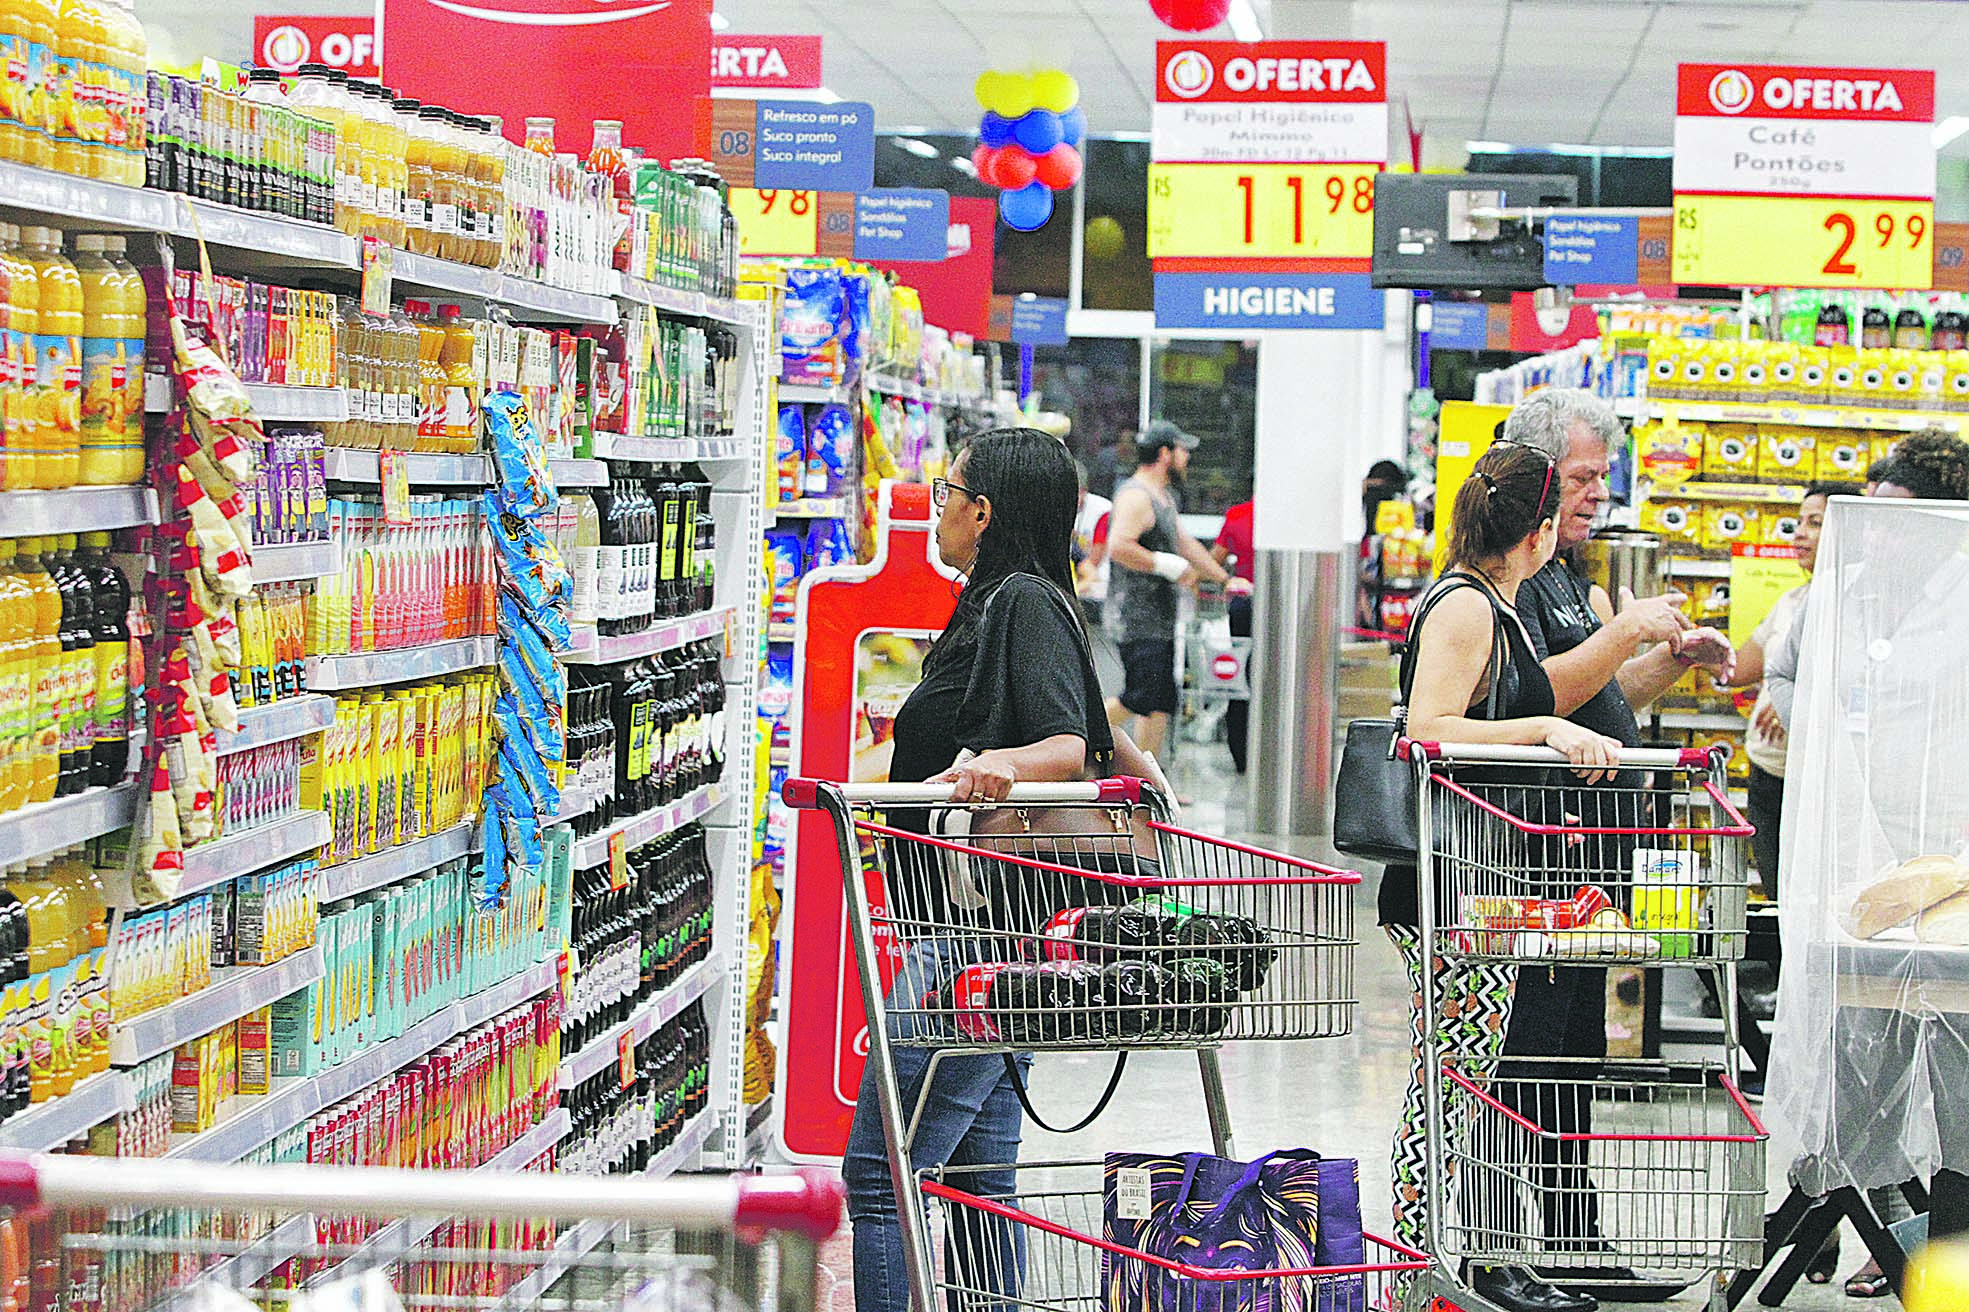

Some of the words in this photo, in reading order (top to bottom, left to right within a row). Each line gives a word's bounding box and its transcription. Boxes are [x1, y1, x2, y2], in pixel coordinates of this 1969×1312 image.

[1223, 57, 1377, 92] OFERTA
[1762, 77, 1903, 113] OFERTA
[763, 108, 817, 124] Refresco
[819, 112, 838, 124] em
[841, 111, 858, 129] pó
[1183, 108, 1242, 126] Papel
[1250, 108, 1355, 126] Higiênico
[719, 130, 749, 156] 08
[763, 128, 793, 143] Suco
[796, 132, 837, 147] pronto
[1748, 125, 1817, 146] Café
[762, 148, 793, 163] Suco
[795, 150, 842, 165] integral
[1732, 151, 1847, 174] Pontões
[1203, 286, 1336, 317] HIGIENE
